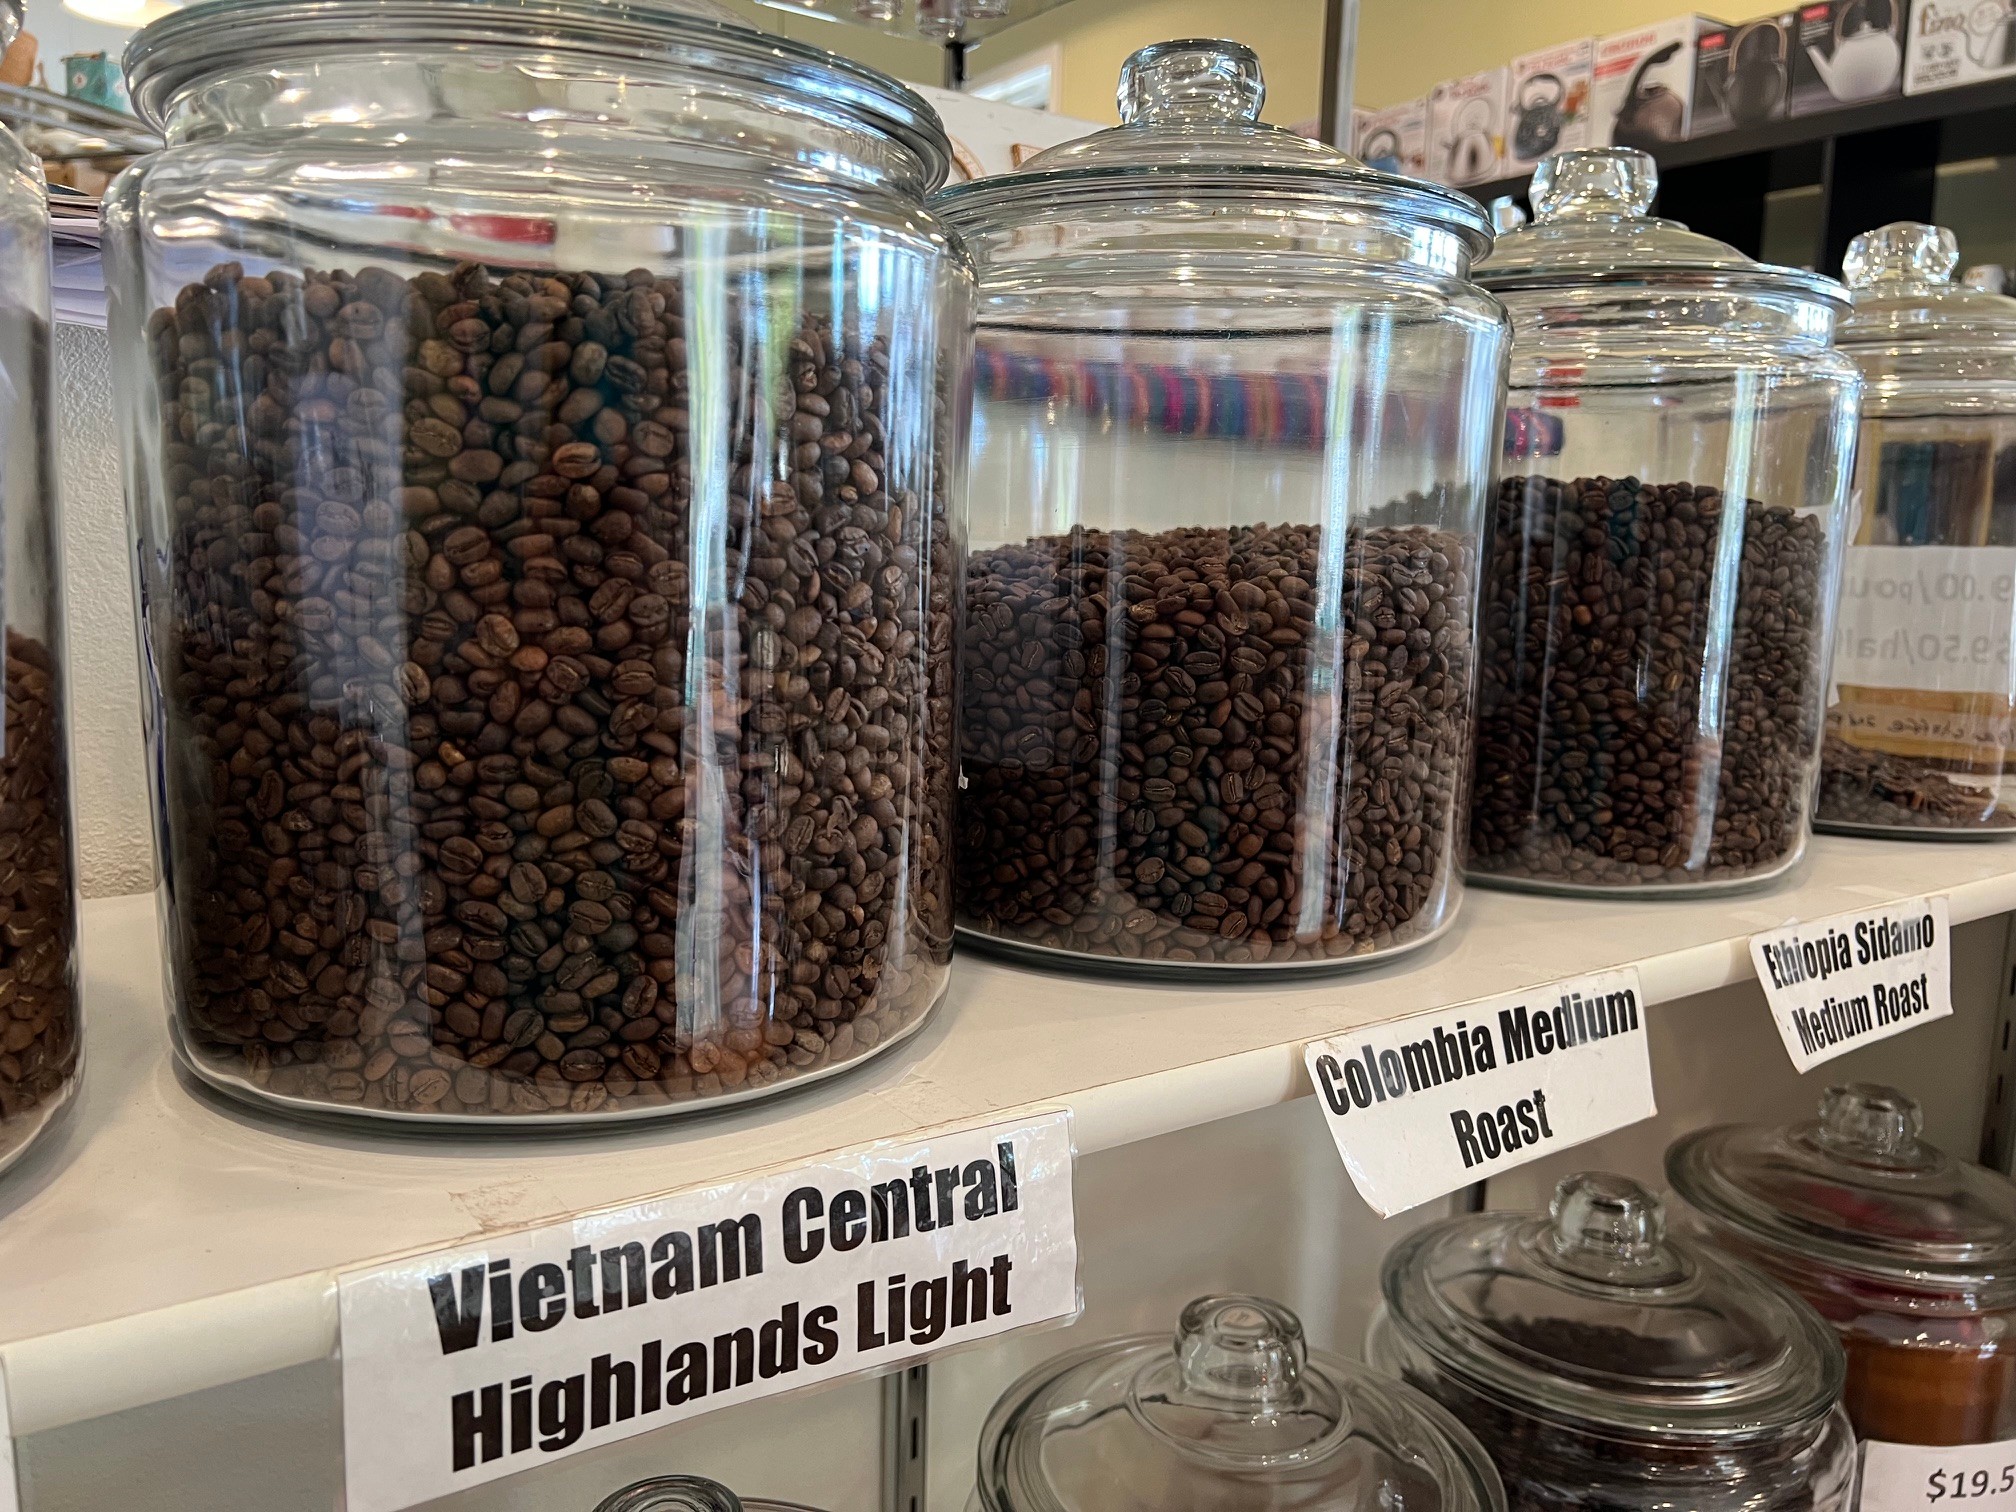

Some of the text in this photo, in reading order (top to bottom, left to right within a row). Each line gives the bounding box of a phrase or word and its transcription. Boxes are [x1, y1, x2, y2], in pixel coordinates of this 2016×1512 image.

[1762, 914, 1934, 990] Ethiopia Sidamo
[1316, 988, 1638, 1116] Colombia Medium
[1792, 973, 1929, 1056] Medium Roast
[1450, 1088, 1554, 1169] Roast
[427, 1142, 1019, 1356] Vietnam Central
[451, 1254, 1012, 1474] Highlands Light
[1926, 1464, 2016, 1503] $19.5
